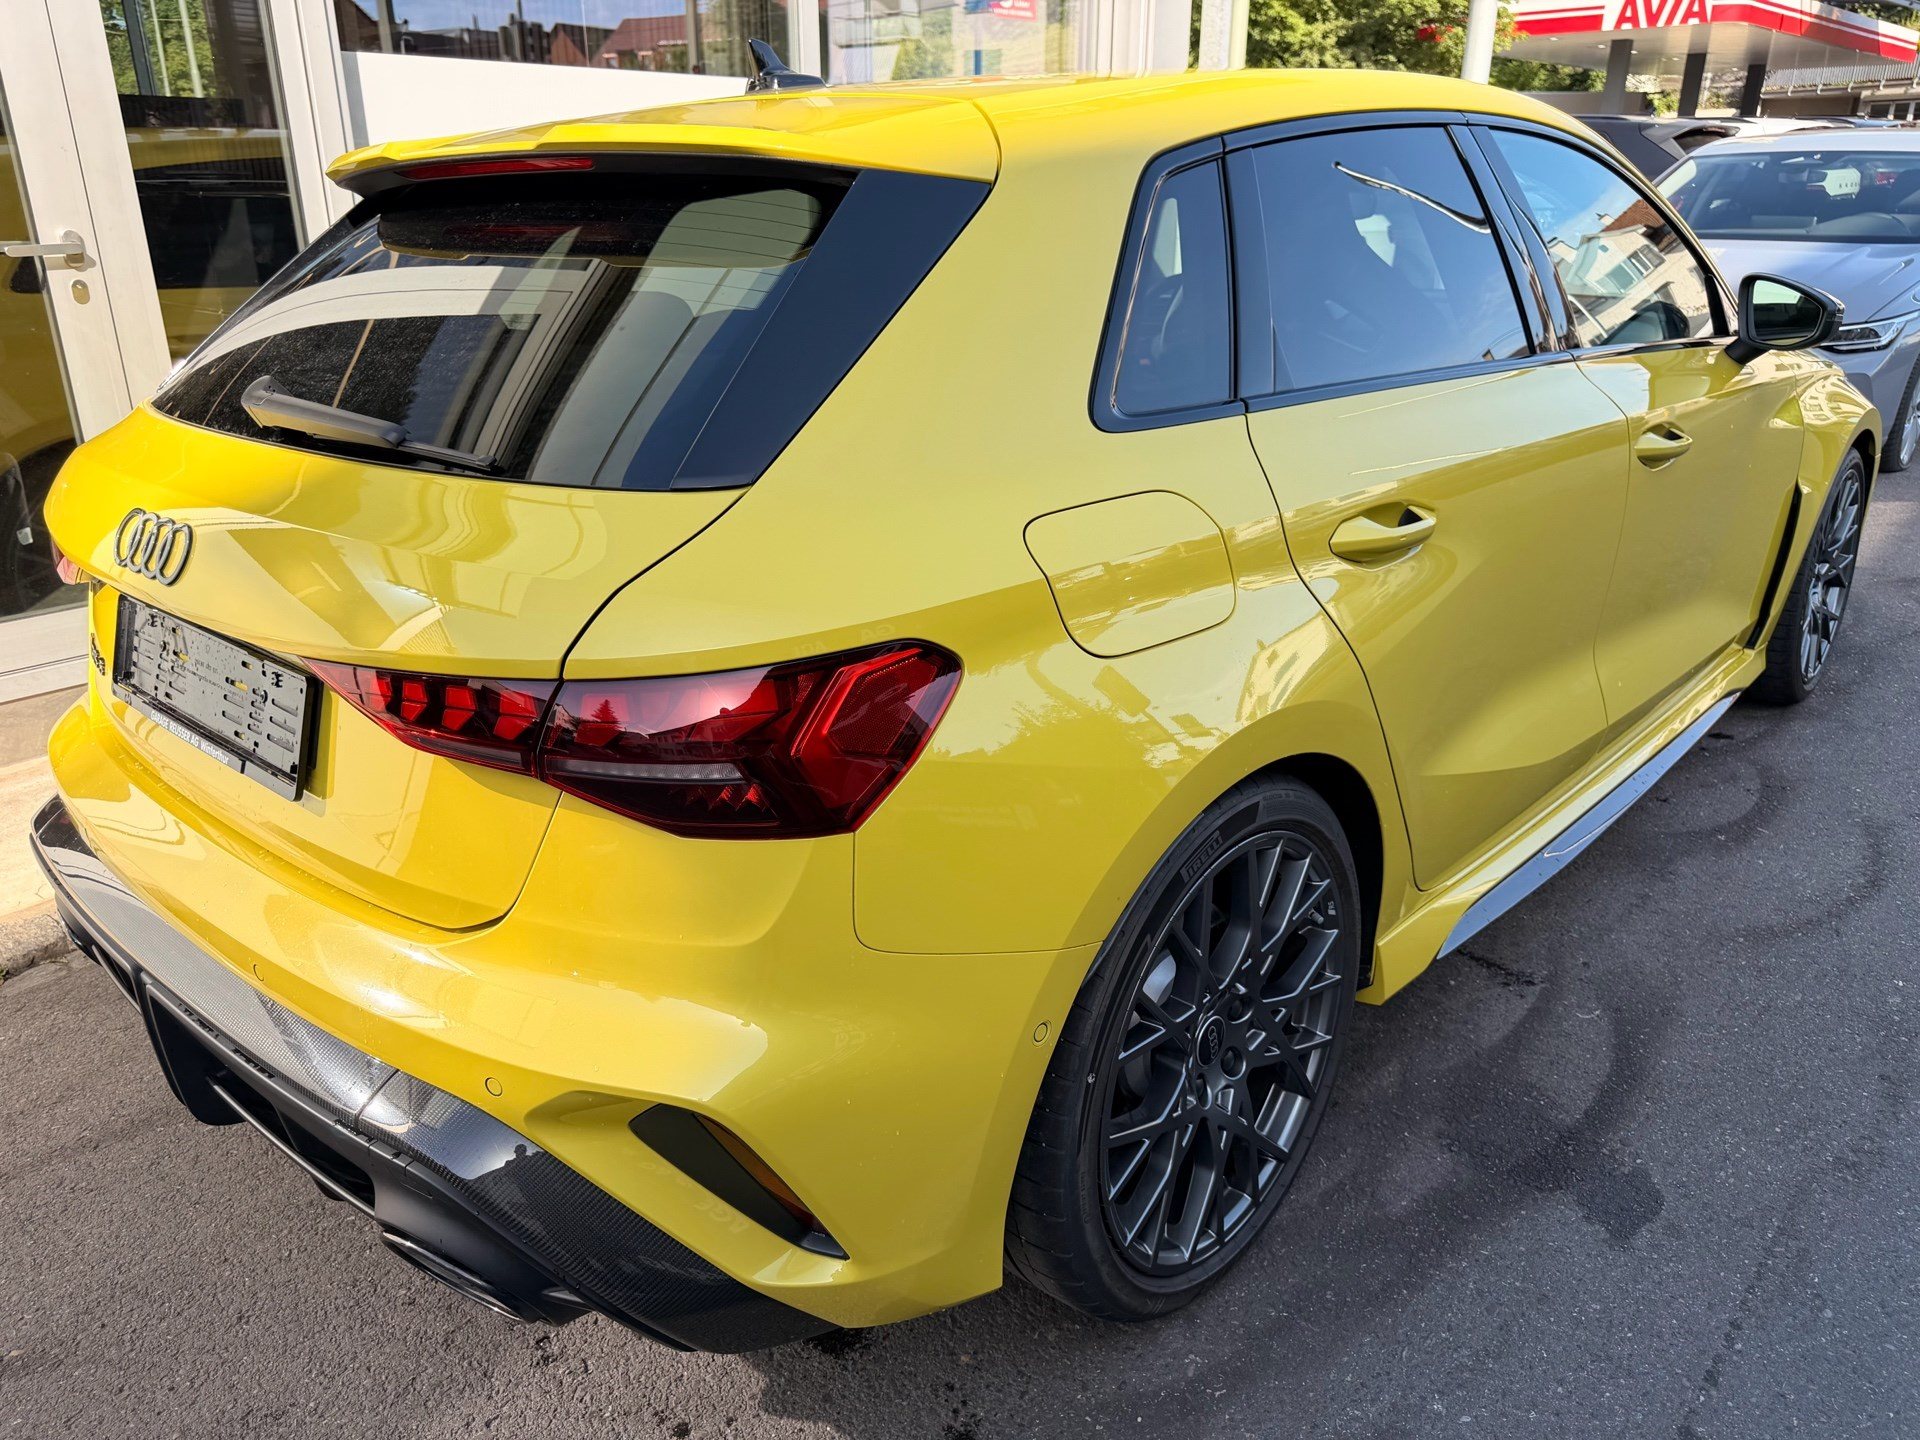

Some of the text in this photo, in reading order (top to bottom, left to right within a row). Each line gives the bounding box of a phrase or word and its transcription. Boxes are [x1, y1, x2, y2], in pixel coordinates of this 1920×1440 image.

[1614, 0, 1709, 30] AVIA
[150, 710, 169, 729] GARAGE
[190, 734, 200, 747] AG
[200, 740, 230, 765] Winterthur
[1180, 830, 1223, 883] PIRELLI
